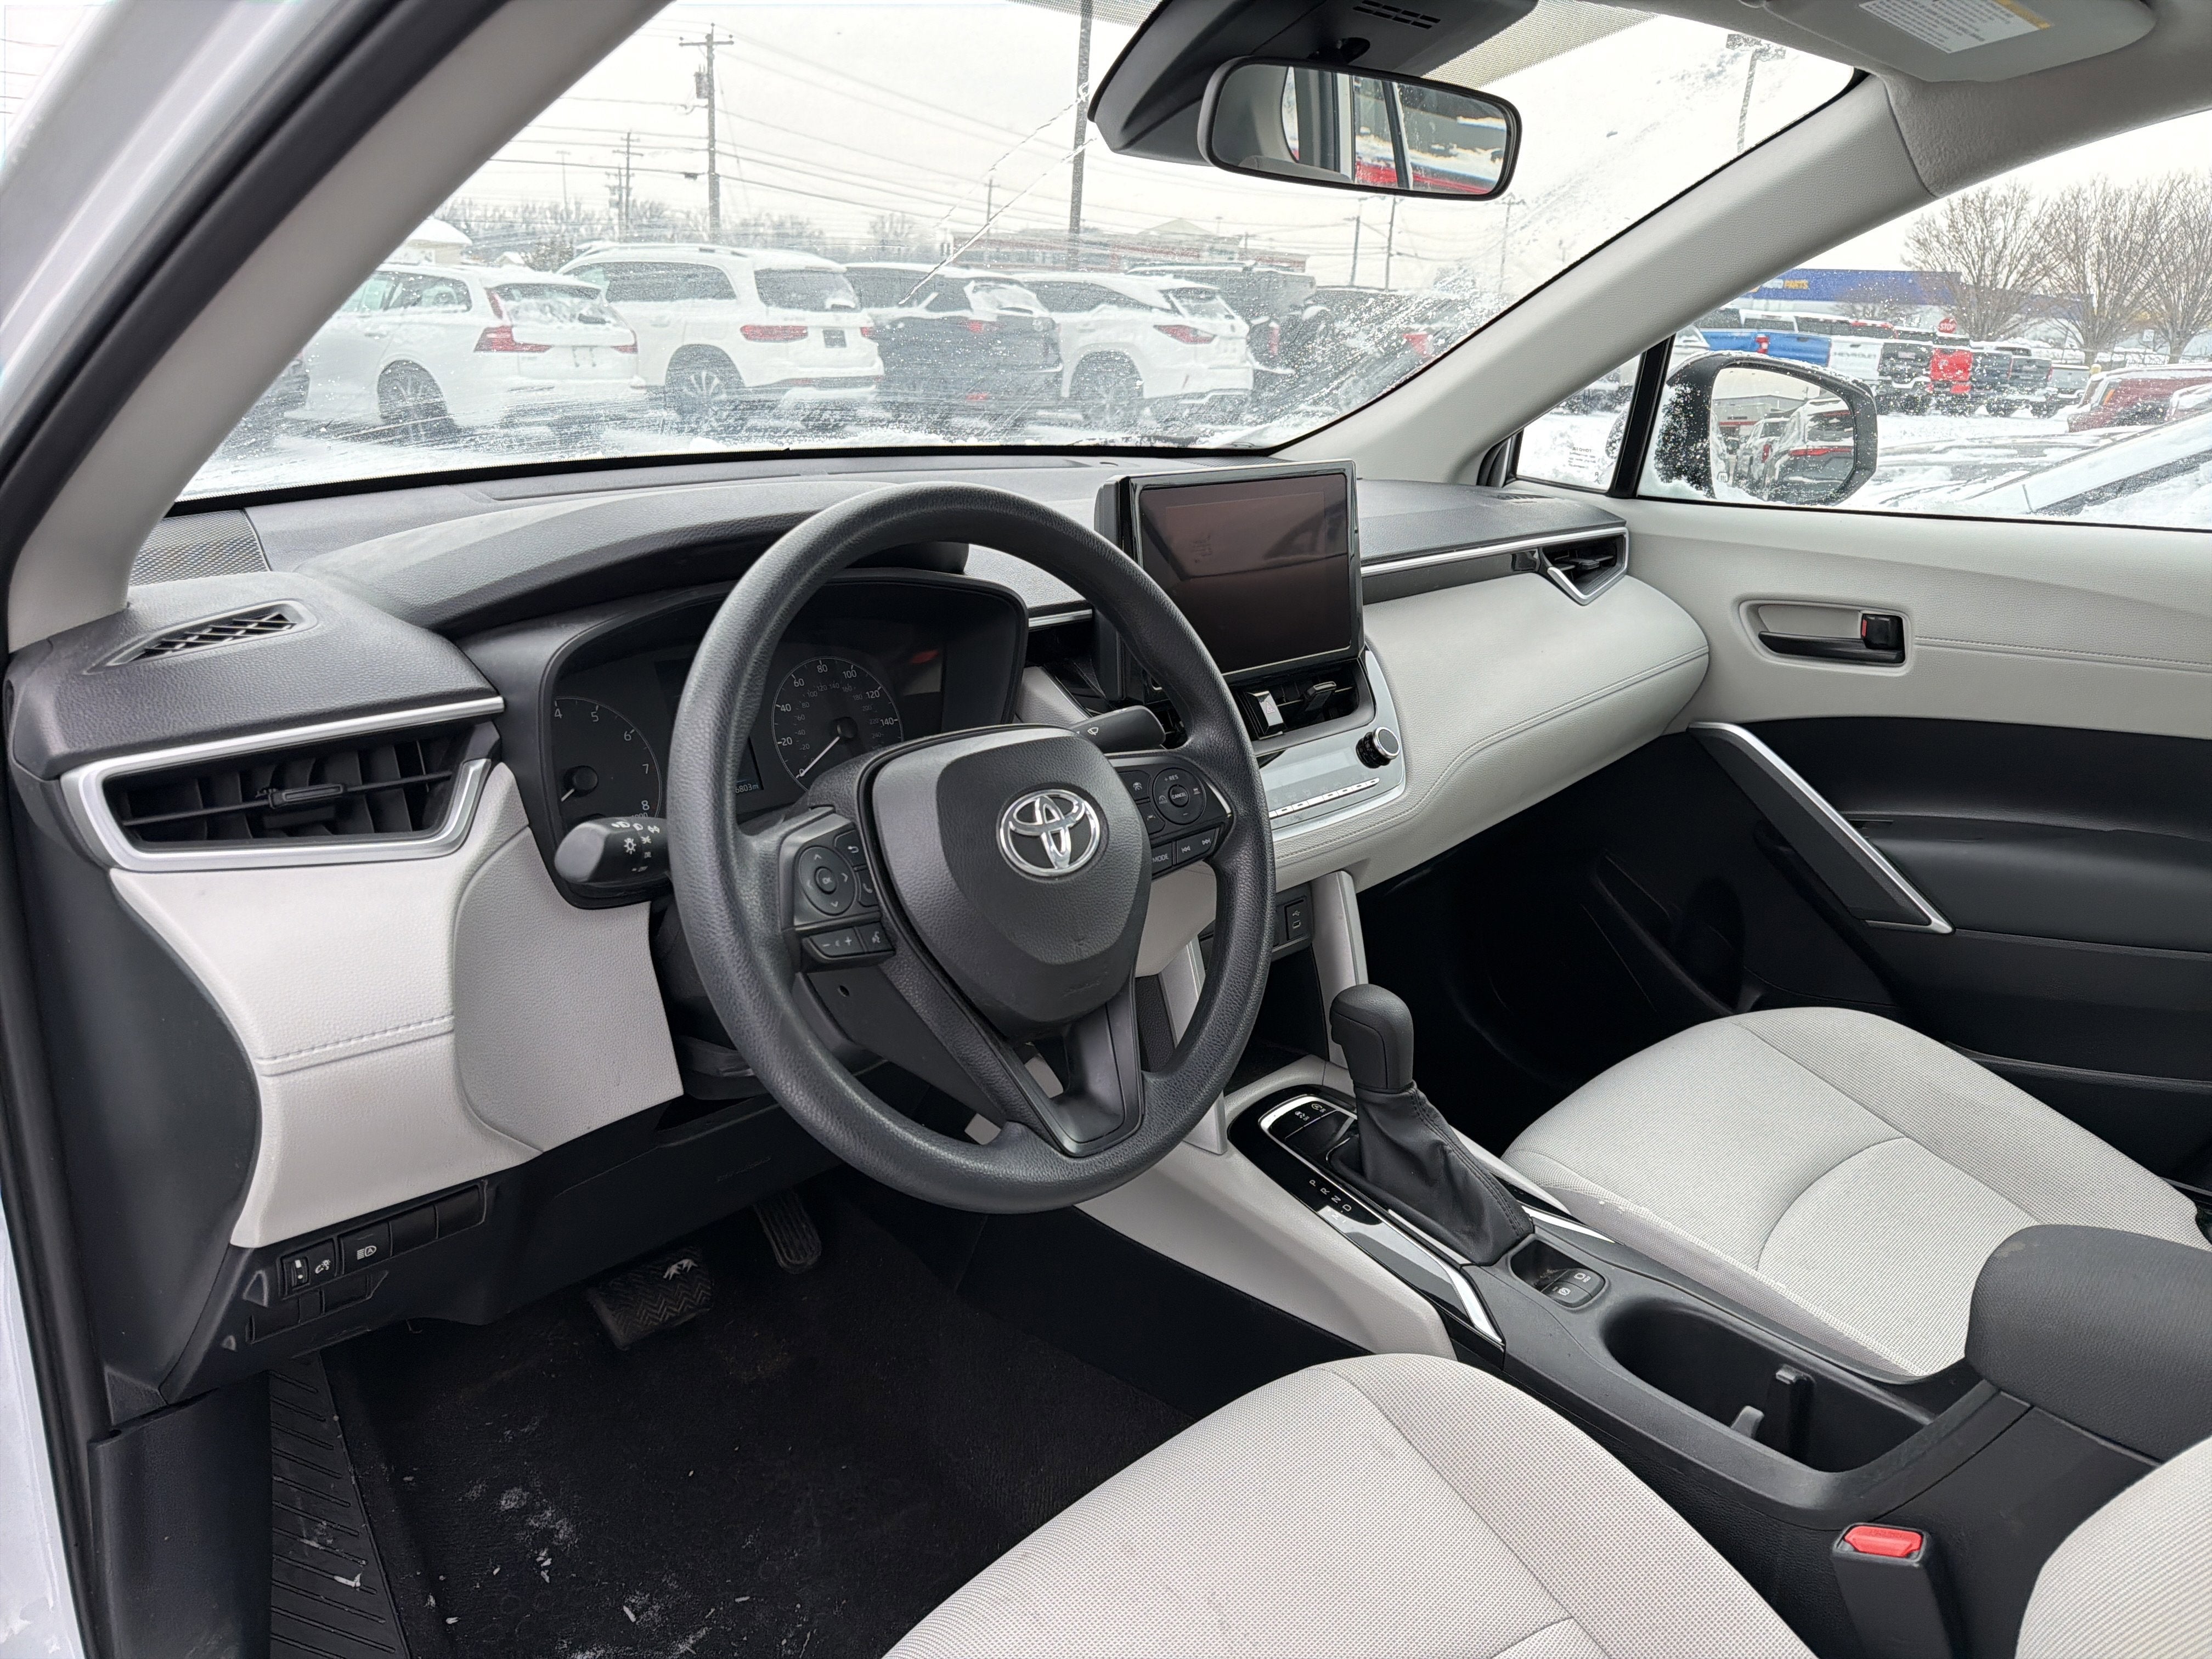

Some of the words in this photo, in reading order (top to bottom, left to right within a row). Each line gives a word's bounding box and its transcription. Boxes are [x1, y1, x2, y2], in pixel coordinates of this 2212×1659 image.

[817, 664, 828, 673] 80
[843, 670, 857, 679] 100
[794, 678, 804, 687] 60
[866, 690, 880, 699] 120
[780, 703, 792, 712] 40
[554, 708, 563, 719] 4
[591, 712, 599, 722] 5
[881, 716, 894, 726] 140
[624, 731, 631, 741] 6
[781, 737, 793, 746] 20
[642, 764, 649, 774] 7
[641, 800, 650, 811] 8
[1152, 853, 1169, 863] MODE
[1331, 1195, 1341, 1204] N
